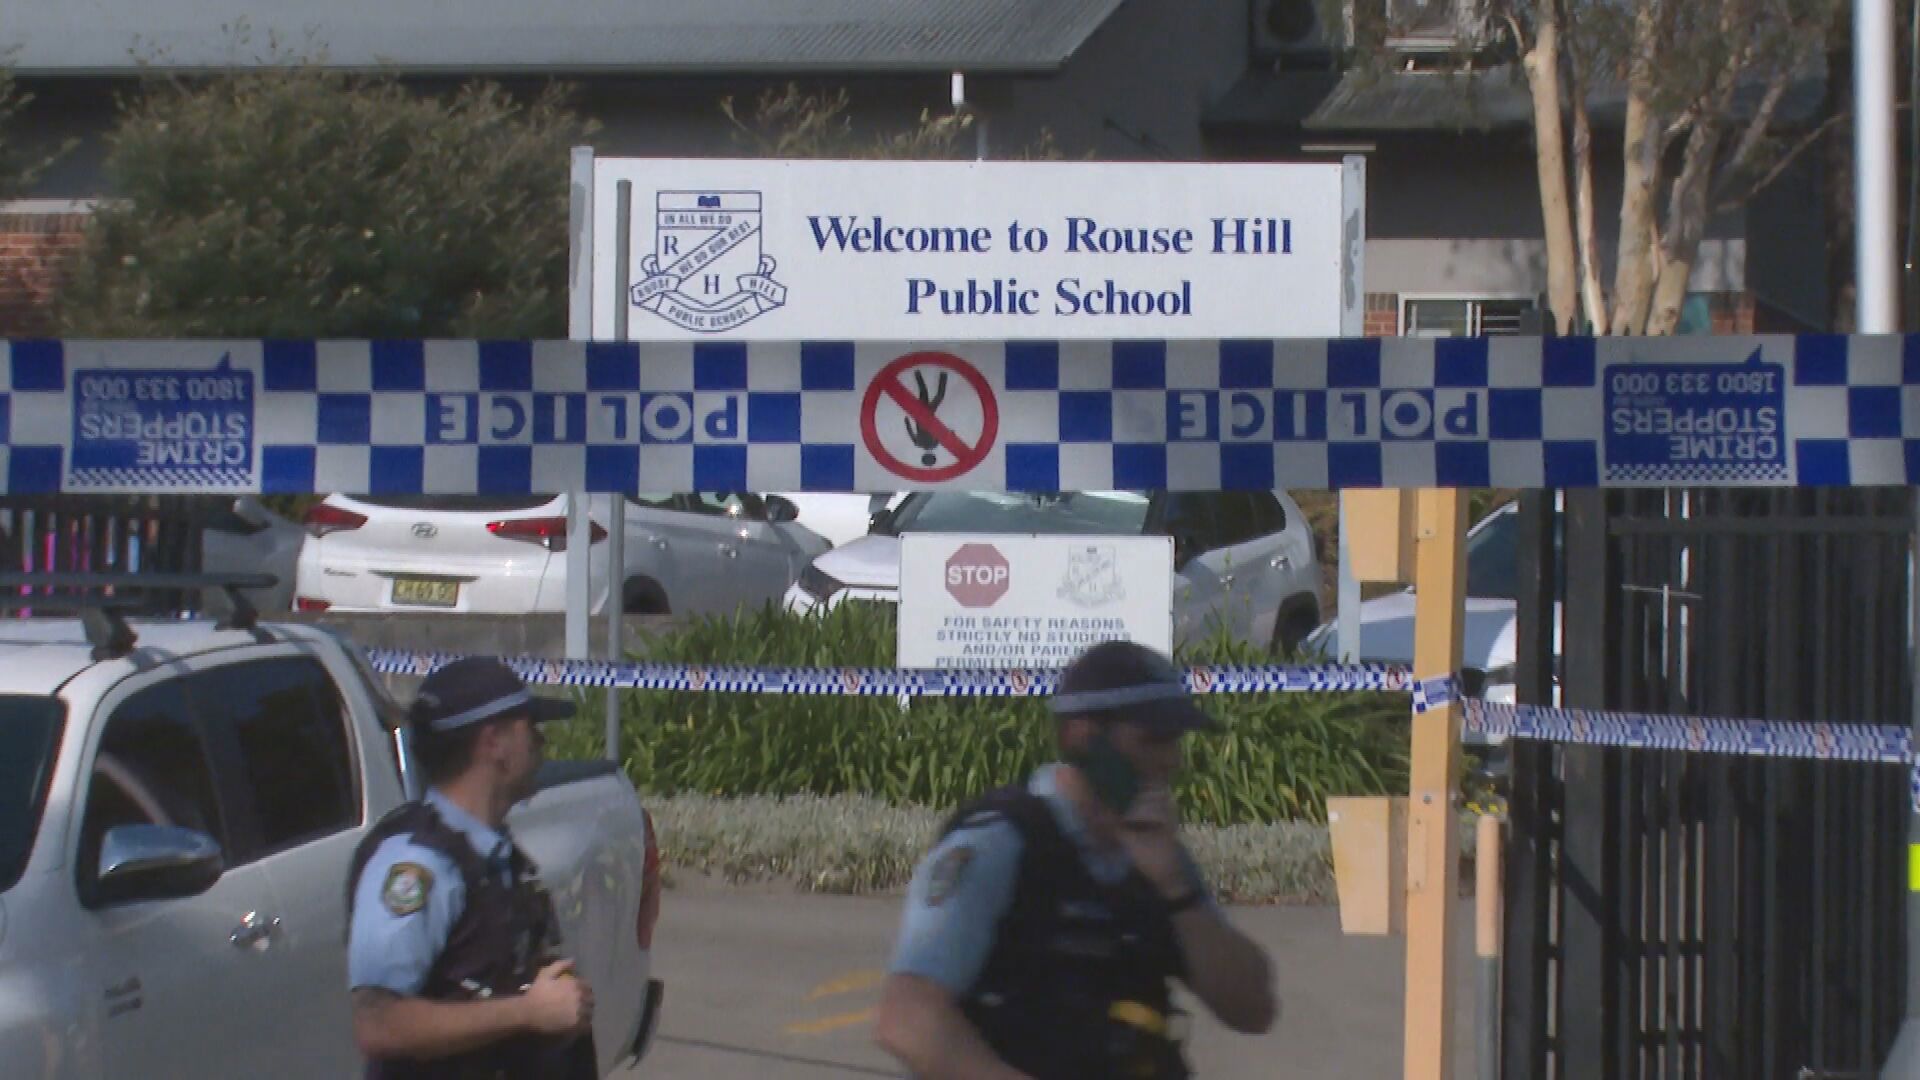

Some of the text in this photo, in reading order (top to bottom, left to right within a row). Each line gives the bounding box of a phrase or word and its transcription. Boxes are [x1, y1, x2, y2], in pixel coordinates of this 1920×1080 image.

[679, 215, 696, 225] ALL
[699, 215, 715, 225] WE
[718, 215, 732, 225] DO
[663, 235, 679, 256] R
[807, 215, 1294, 255] Welcome to Rouse Hill
[703, 273, 720, 295] H
[905, 278, 1193, 316] Public School
[668, 305, 750, 328] PUBLIC SCHOOL
[81, 377, 245, 400] 1800 333 000
[1612, 372, 1776, 393] 1800 333 000
[81, 412, 246, 440] STOPPERS
[440, 395, 738, 440] POLICE
[1180, 391, 1479, 439] POLICE
[1612, 406, 1777, 433] STOPPERS
[136, 440, 246, 465] CRIME
[1669, 435, 1777, 459] CRIME
[947, 564, 1008, 585] STOP
[943, 616, 1125, 630] FOR SAFETY REASONS
[936, 629, 1131, 643] STRICTLY NO STUDENTS
[963, 643, 1025, 656] AND/OR
